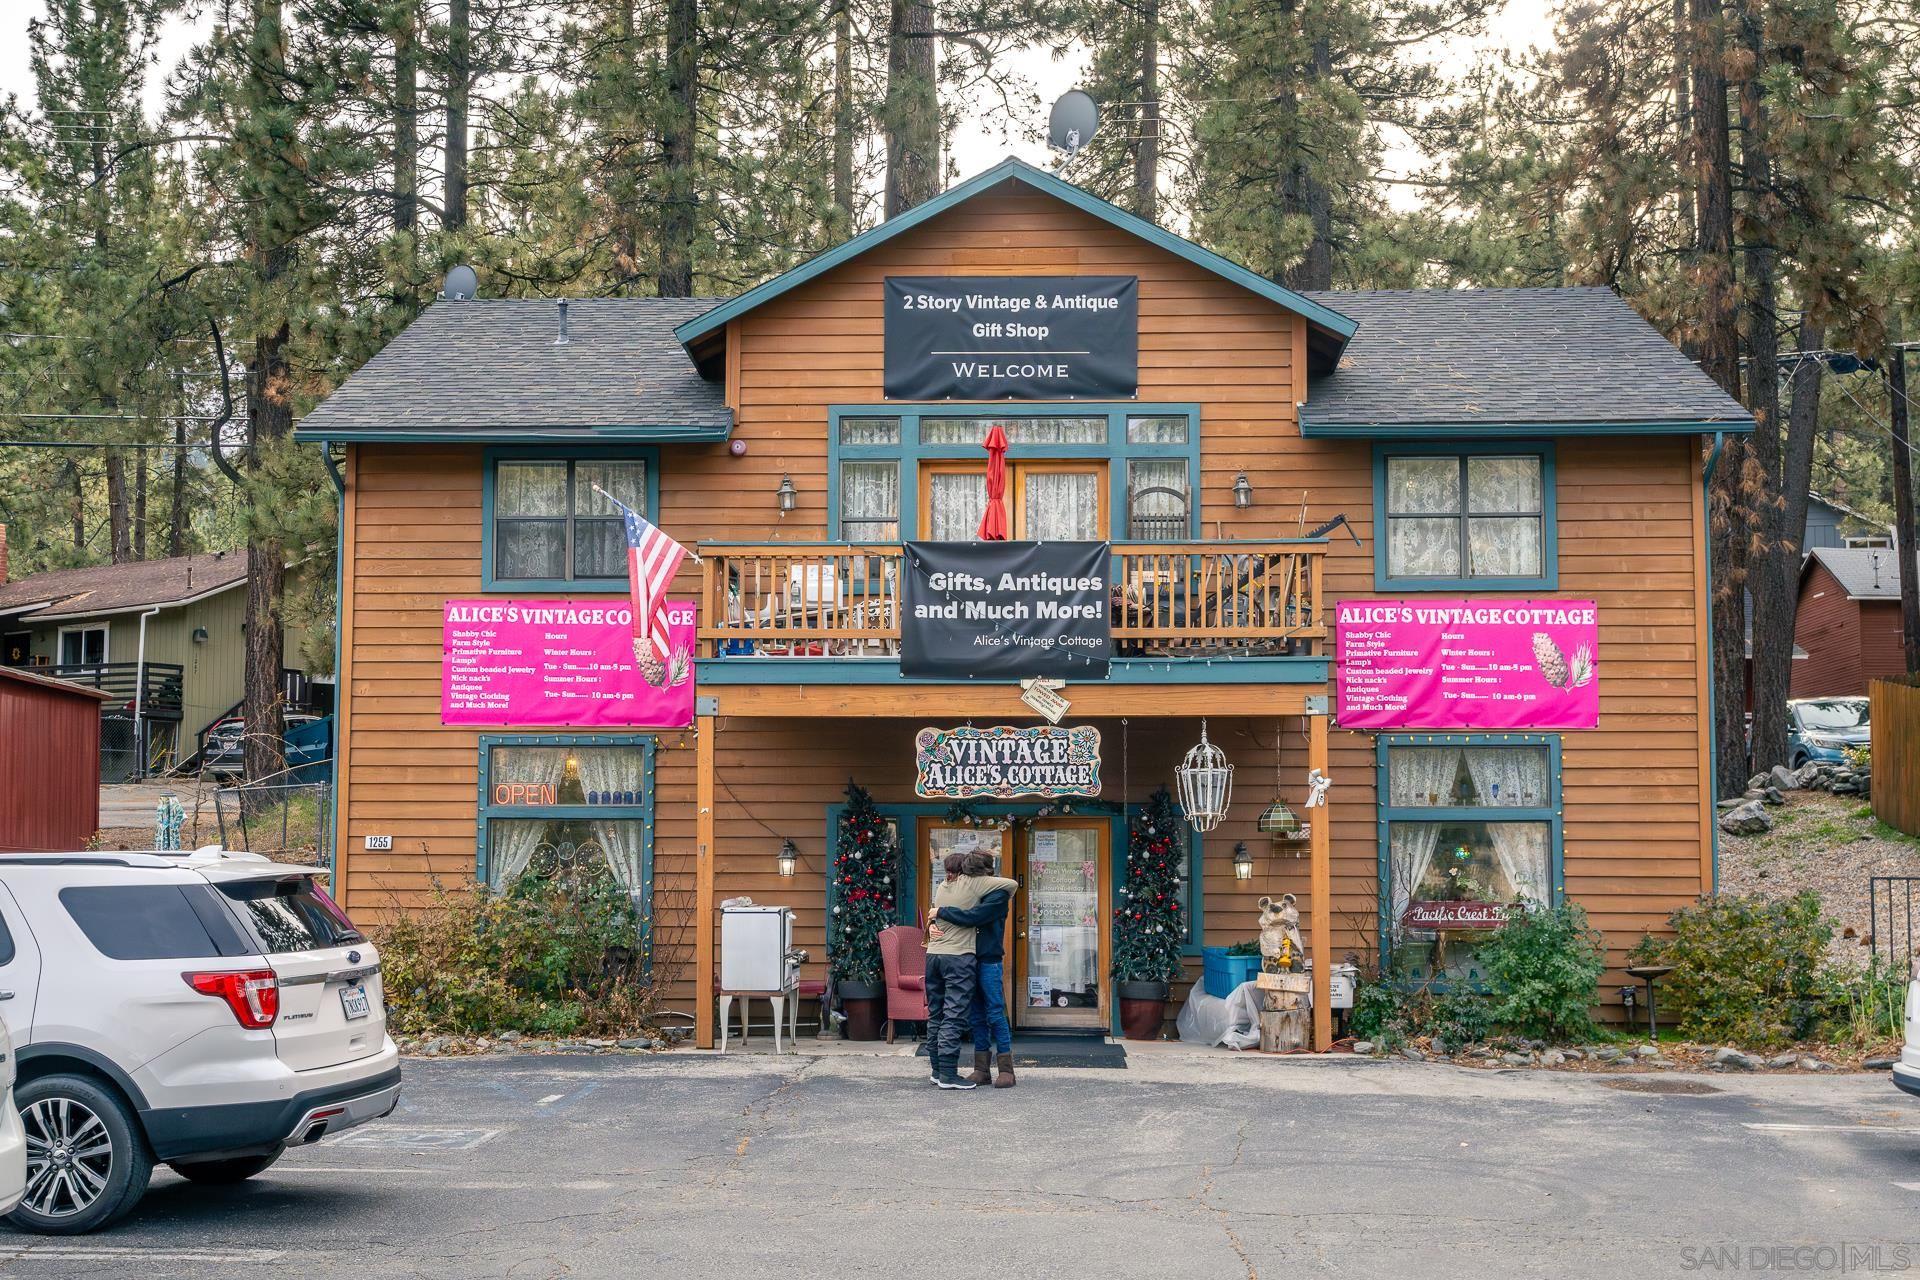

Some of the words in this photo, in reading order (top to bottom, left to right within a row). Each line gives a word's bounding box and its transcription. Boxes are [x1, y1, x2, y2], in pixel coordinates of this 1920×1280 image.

[903, 295, 913, 310] 2
[917, 295, 962, 312] Story
[966, 294, 1031, 312] Vintage
[1035, 294, 1048, 310] &
[1052, 294, 1119, 312] Antique
[972, 323, 1002, 338] Gift
[1005, 323, 1049, 340] Shop
[952, 362, 1069, 378] WELCOME
[931, 573, 992, 594] Gifts,
[997, 572, 1103, 596] Antiques
[914, 601, 957, 619] and
[965, 601, 1029, 619] Much
[1036, 601, 1103, 619] More!
[447, 607, 519, 623] ALICE'S
[521, 608, 603, 625] VINTAGE
[606, 609, 694, 626] COGE
[1340, 608, 1413, 623] ALICE'S
[1415, 609, 1501, 625] VINTAGE
[1503, 609, 1595, 625] COTTAGE
[452, 631, 479, 639] Shabby
[472, 640, 490, 648] Style
[973, 634, 1010, 646] Alice's
[1013, 635, 1055, 650] Vintage
[1058, 634, 1103, 650] Cottage
[1366, 641, 1385, 649] Style
[488, 648, 523, 656] Furniture
[544, 648, 568, 656] Winter
[570, 648, 592, 656] Hours
[1383, 649, 1419, 657] Furniture
[1441, 648, 1466, 656] Winter
[1468, 648, 1490, 656] Hours
[1345, 659, 1372, 667] Lamp's
[1441, 663, 1455, 671] Tue
[508, 666, 536, 675] Jewelry
[1405, 668, 1433, 676] Jewelry
[1346, 686, 1379, 694] Antiques
[479, 693, 510, 701] Clothing
[622, 693, 634, 701] pm
[1346, 695, 1375, 703] Vintage
[1376, 695, 1408, 703] Clothing
[949, 738, 1068, 764] VINTAGE
[926, 763, 1001, 788] ALICE'S
[1007, 764, 1091, 785] COTTAGE
[496, 784, 555, 805] OPEN
[369, 836, 388, 848] 1255
[1413, 906, 1454, 924] Pacific
[1457, 906, 1488, 921] Crest
